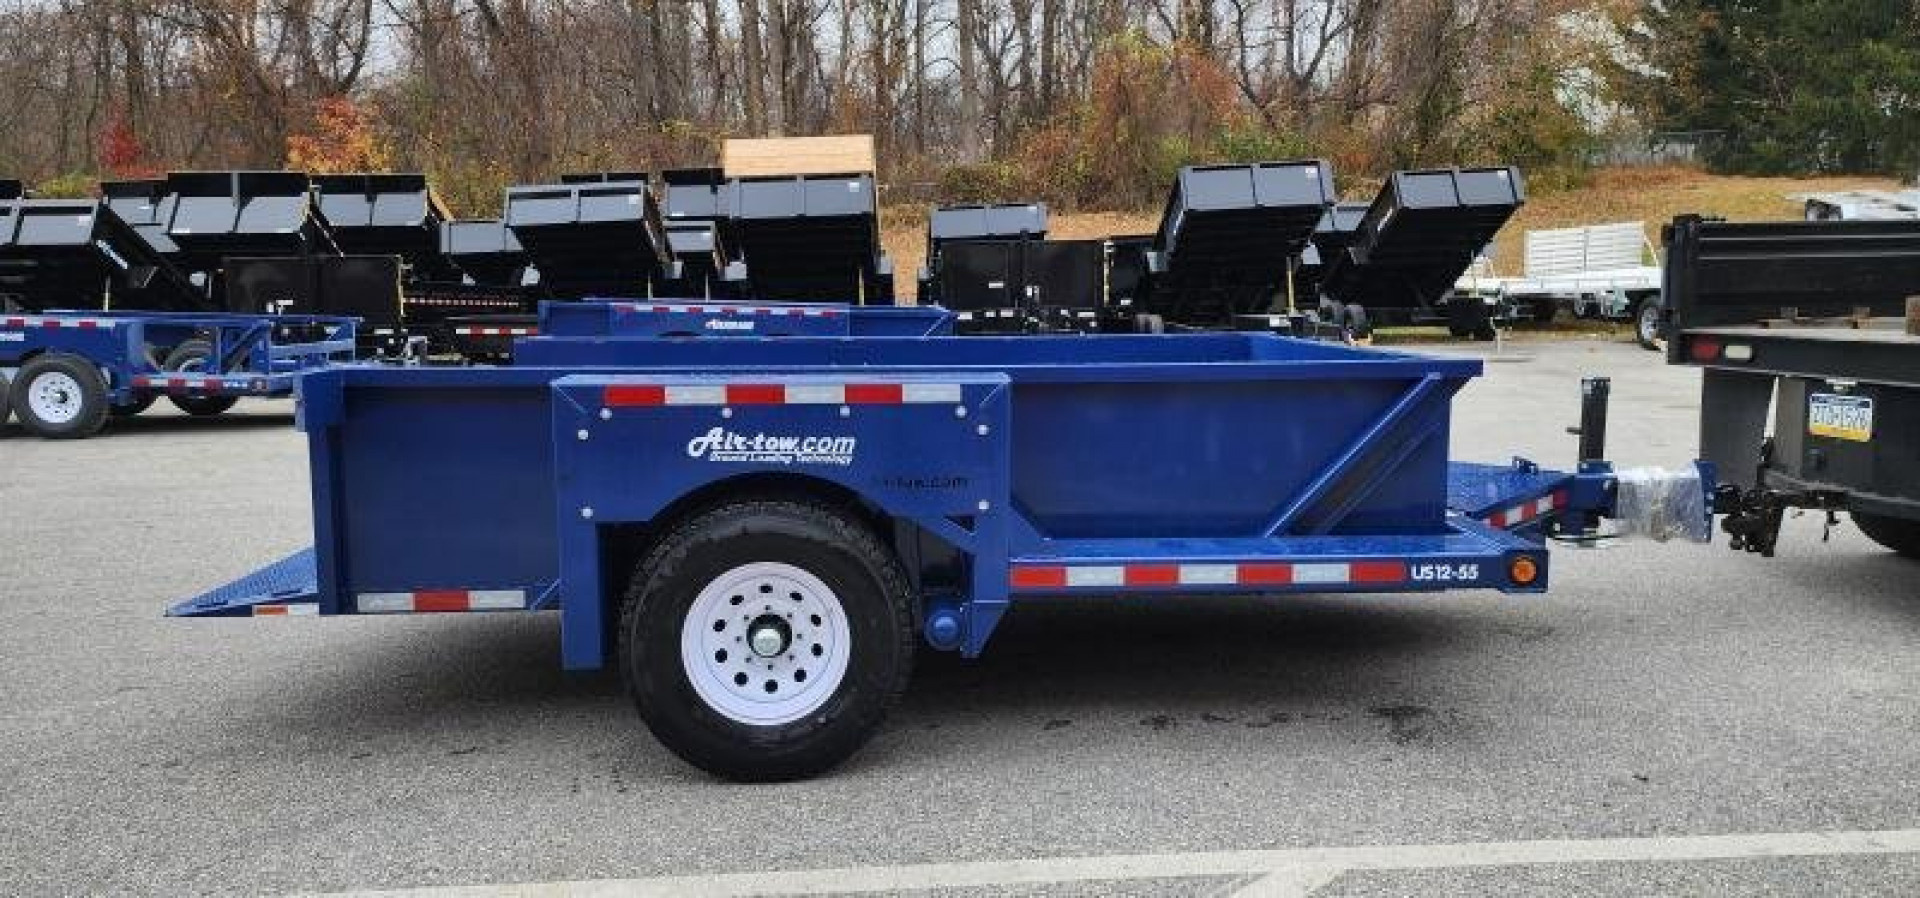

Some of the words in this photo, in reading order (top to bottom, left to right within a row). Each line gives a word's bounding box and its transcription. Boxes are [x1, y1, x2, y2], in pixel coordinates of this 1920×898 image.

[687, 426, 855, 456] Air-tow.com
[795, 452, 854, 465] Technology
[1411, 563, 1480, 580] US12-55
